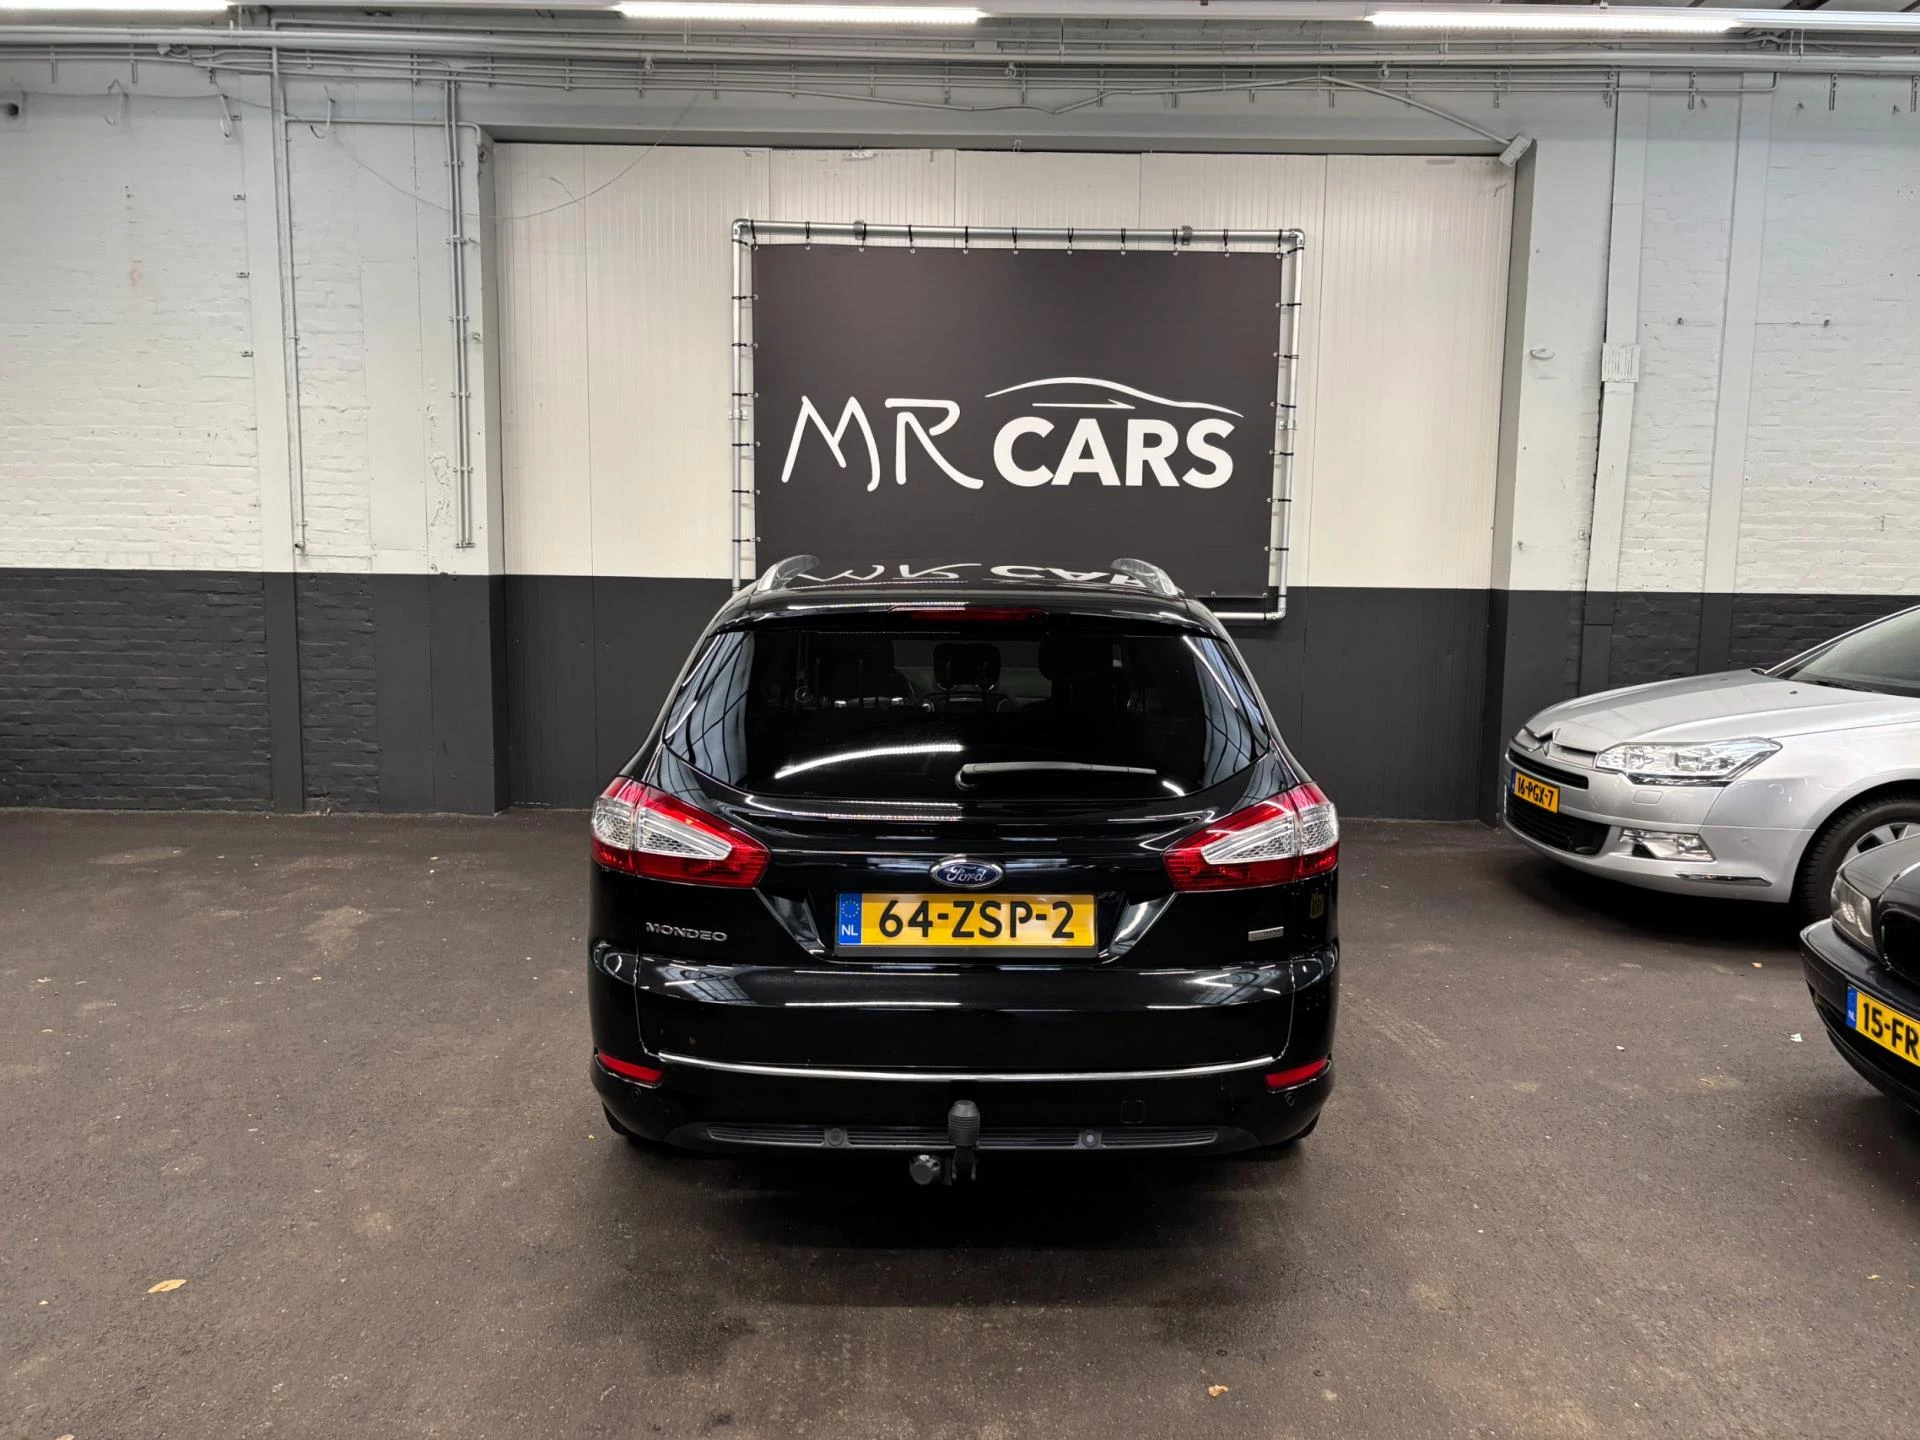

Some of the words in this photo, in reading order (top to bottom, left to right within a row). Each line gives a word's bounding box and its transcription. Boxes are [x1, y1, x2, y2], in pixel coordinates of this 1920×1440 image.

[781, 395, 984, 492] MR
[993, 416, 1234, 488] CARS
[1518, 777, 1554, 807] 16-PGX-7
[946, 866, 987, 881] Ford
[645, 922, 728, 941] MONDEO
[841, 924, 858, 936] NL
[879, 900, 1075, 939] 64-ZSP-2
